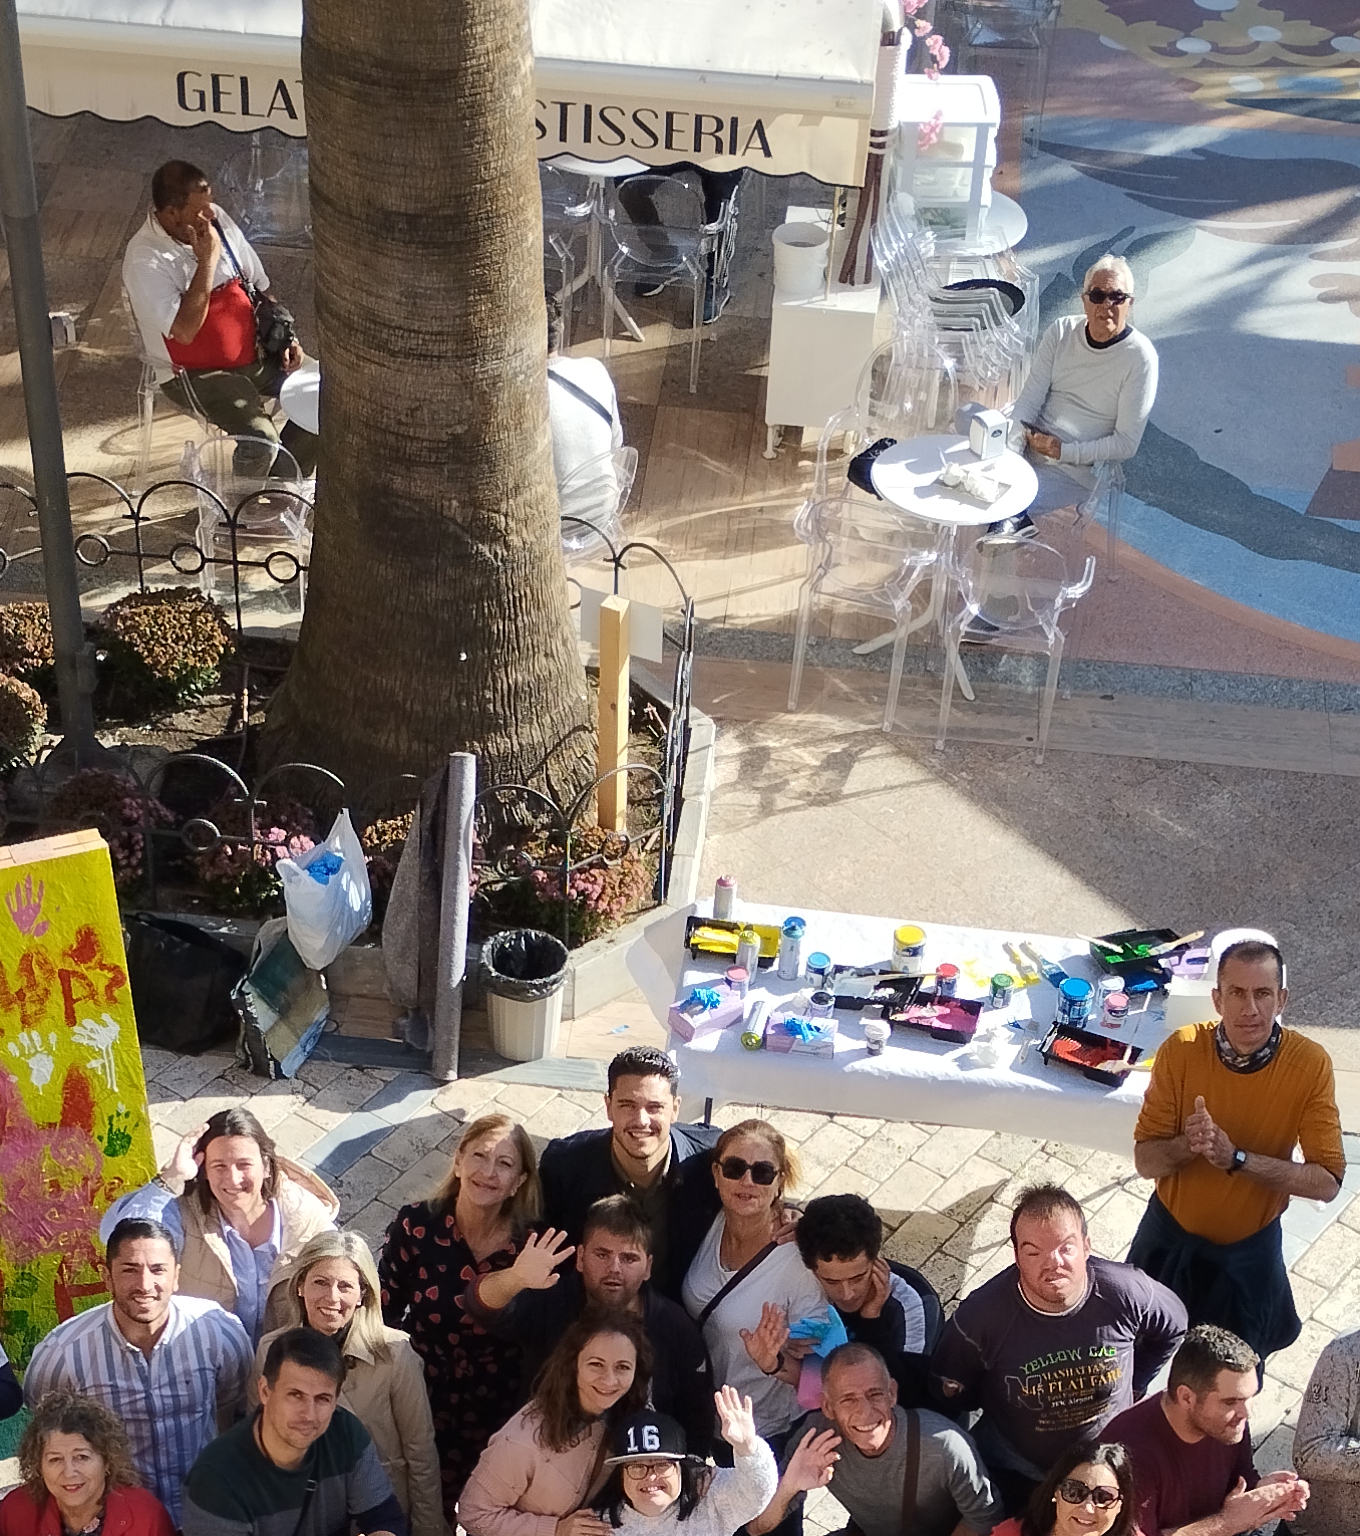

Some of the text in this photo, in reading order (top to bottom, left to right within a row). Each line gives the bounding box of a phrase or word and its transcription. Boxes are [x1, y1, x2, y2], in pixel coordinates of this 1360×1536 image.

[176, 70, 303, 121] GELA
[1019, 1347, 1082, 1375] YELLOW
[626, 1425, 661, 1453] 16
